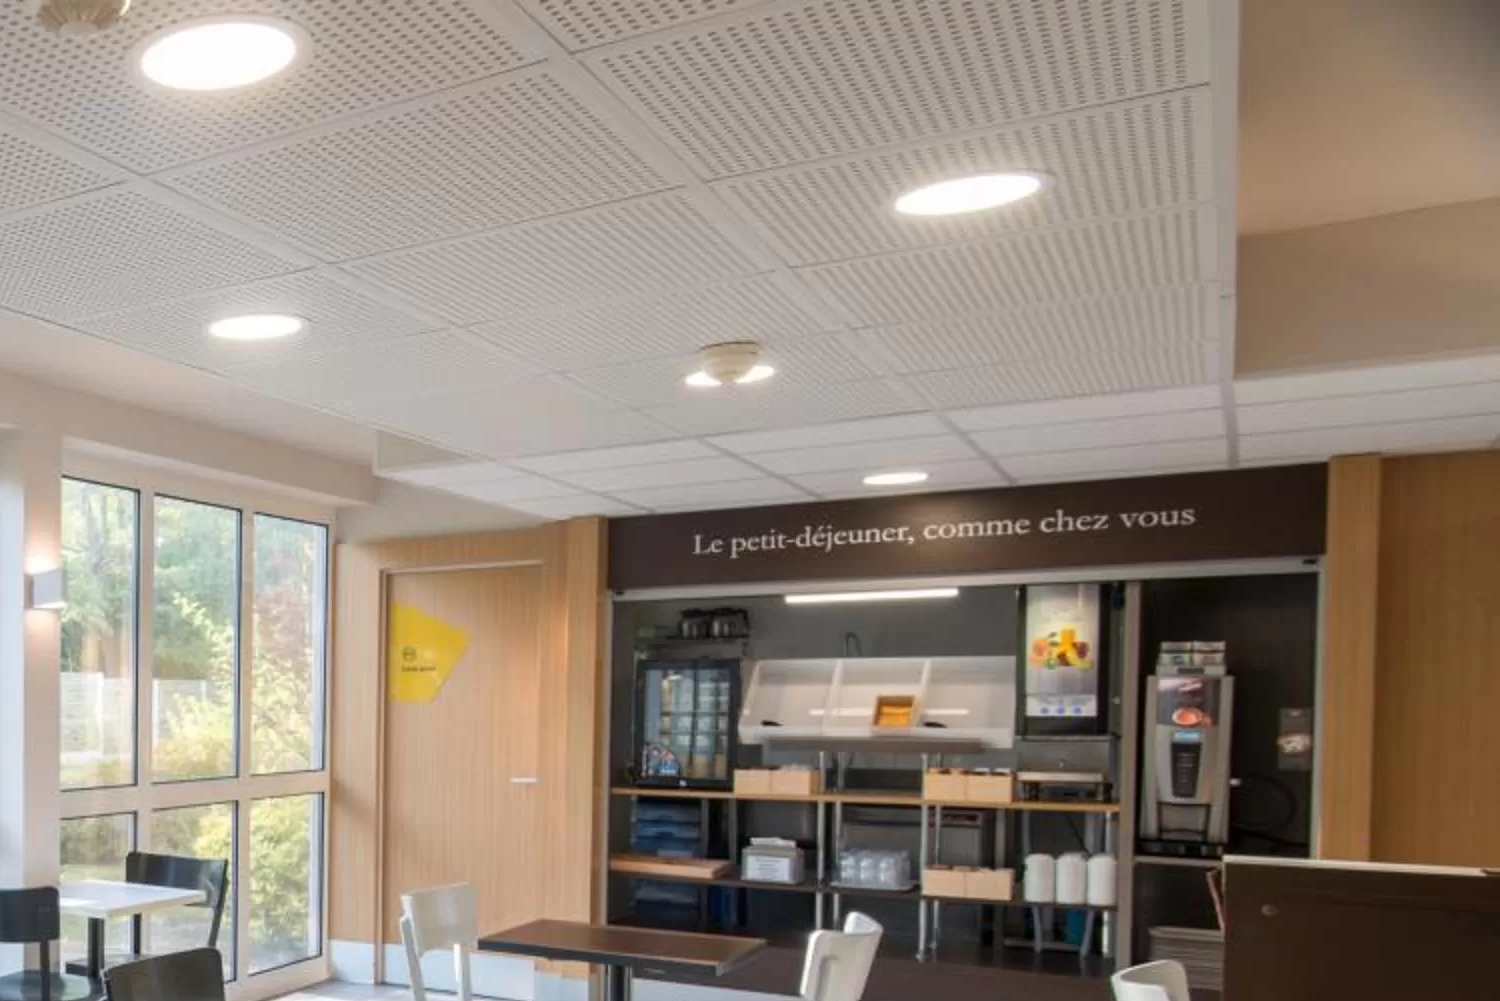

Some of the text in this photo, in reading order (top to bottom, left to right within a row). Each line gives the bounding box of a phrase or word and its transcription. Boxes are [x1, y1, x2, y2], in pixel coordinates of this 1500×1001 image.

[692, 507, 1197, 559] Le petit-déjeuner, comme chez vous
